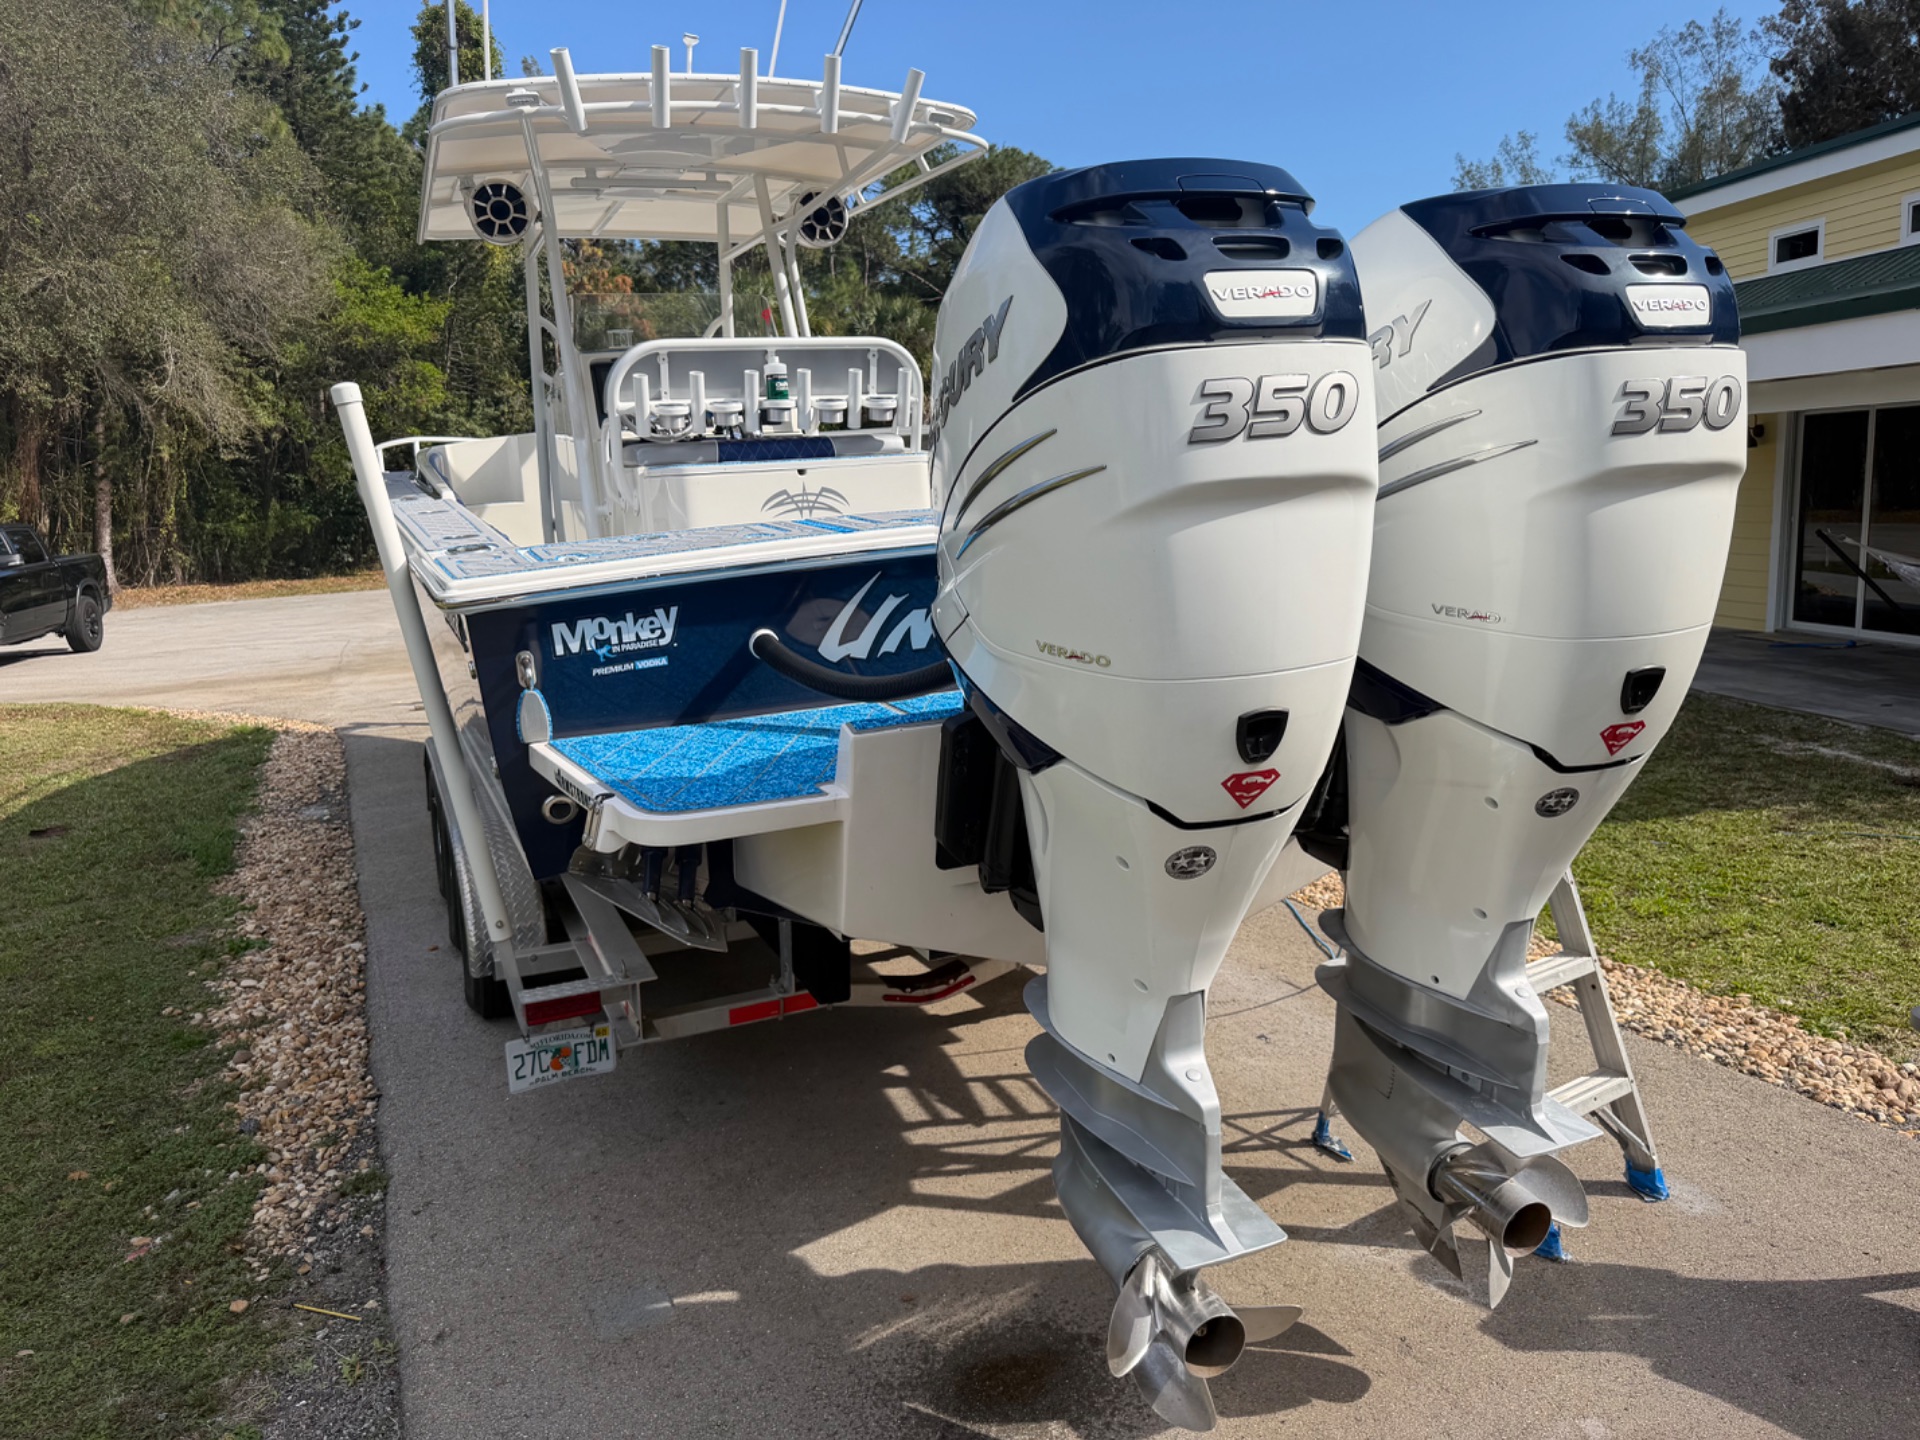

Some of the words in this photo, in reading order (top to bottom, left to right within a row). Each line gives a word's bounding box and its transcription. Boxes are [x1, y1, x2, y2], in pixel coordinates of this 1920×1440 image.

[1212, 284, 1313, 302] VERADO
[1632, 299, 1708, 313] VERADO
[1188, 370, 1360, 446] 350
[1610, 374, 1743, 437] 350
[1431, 603, 1507, 624] VERAD
[550, 605, 679, 657] Monkey
[611, 644, 622, 653] IN
[621, 639, 660, 653] PARADISE
[1035, 639, 1112, 668] VERADO
[592, 662, 635, 677] PREMIUM
[636, 657, 668, 670] VODKA
[513, 1049, 551, 1080] 27C
[573, 1038, 610, 1067] FDM
[534, 1073, 559, 1085] PALM
[561, 1066, 592, 1077] BEACH
